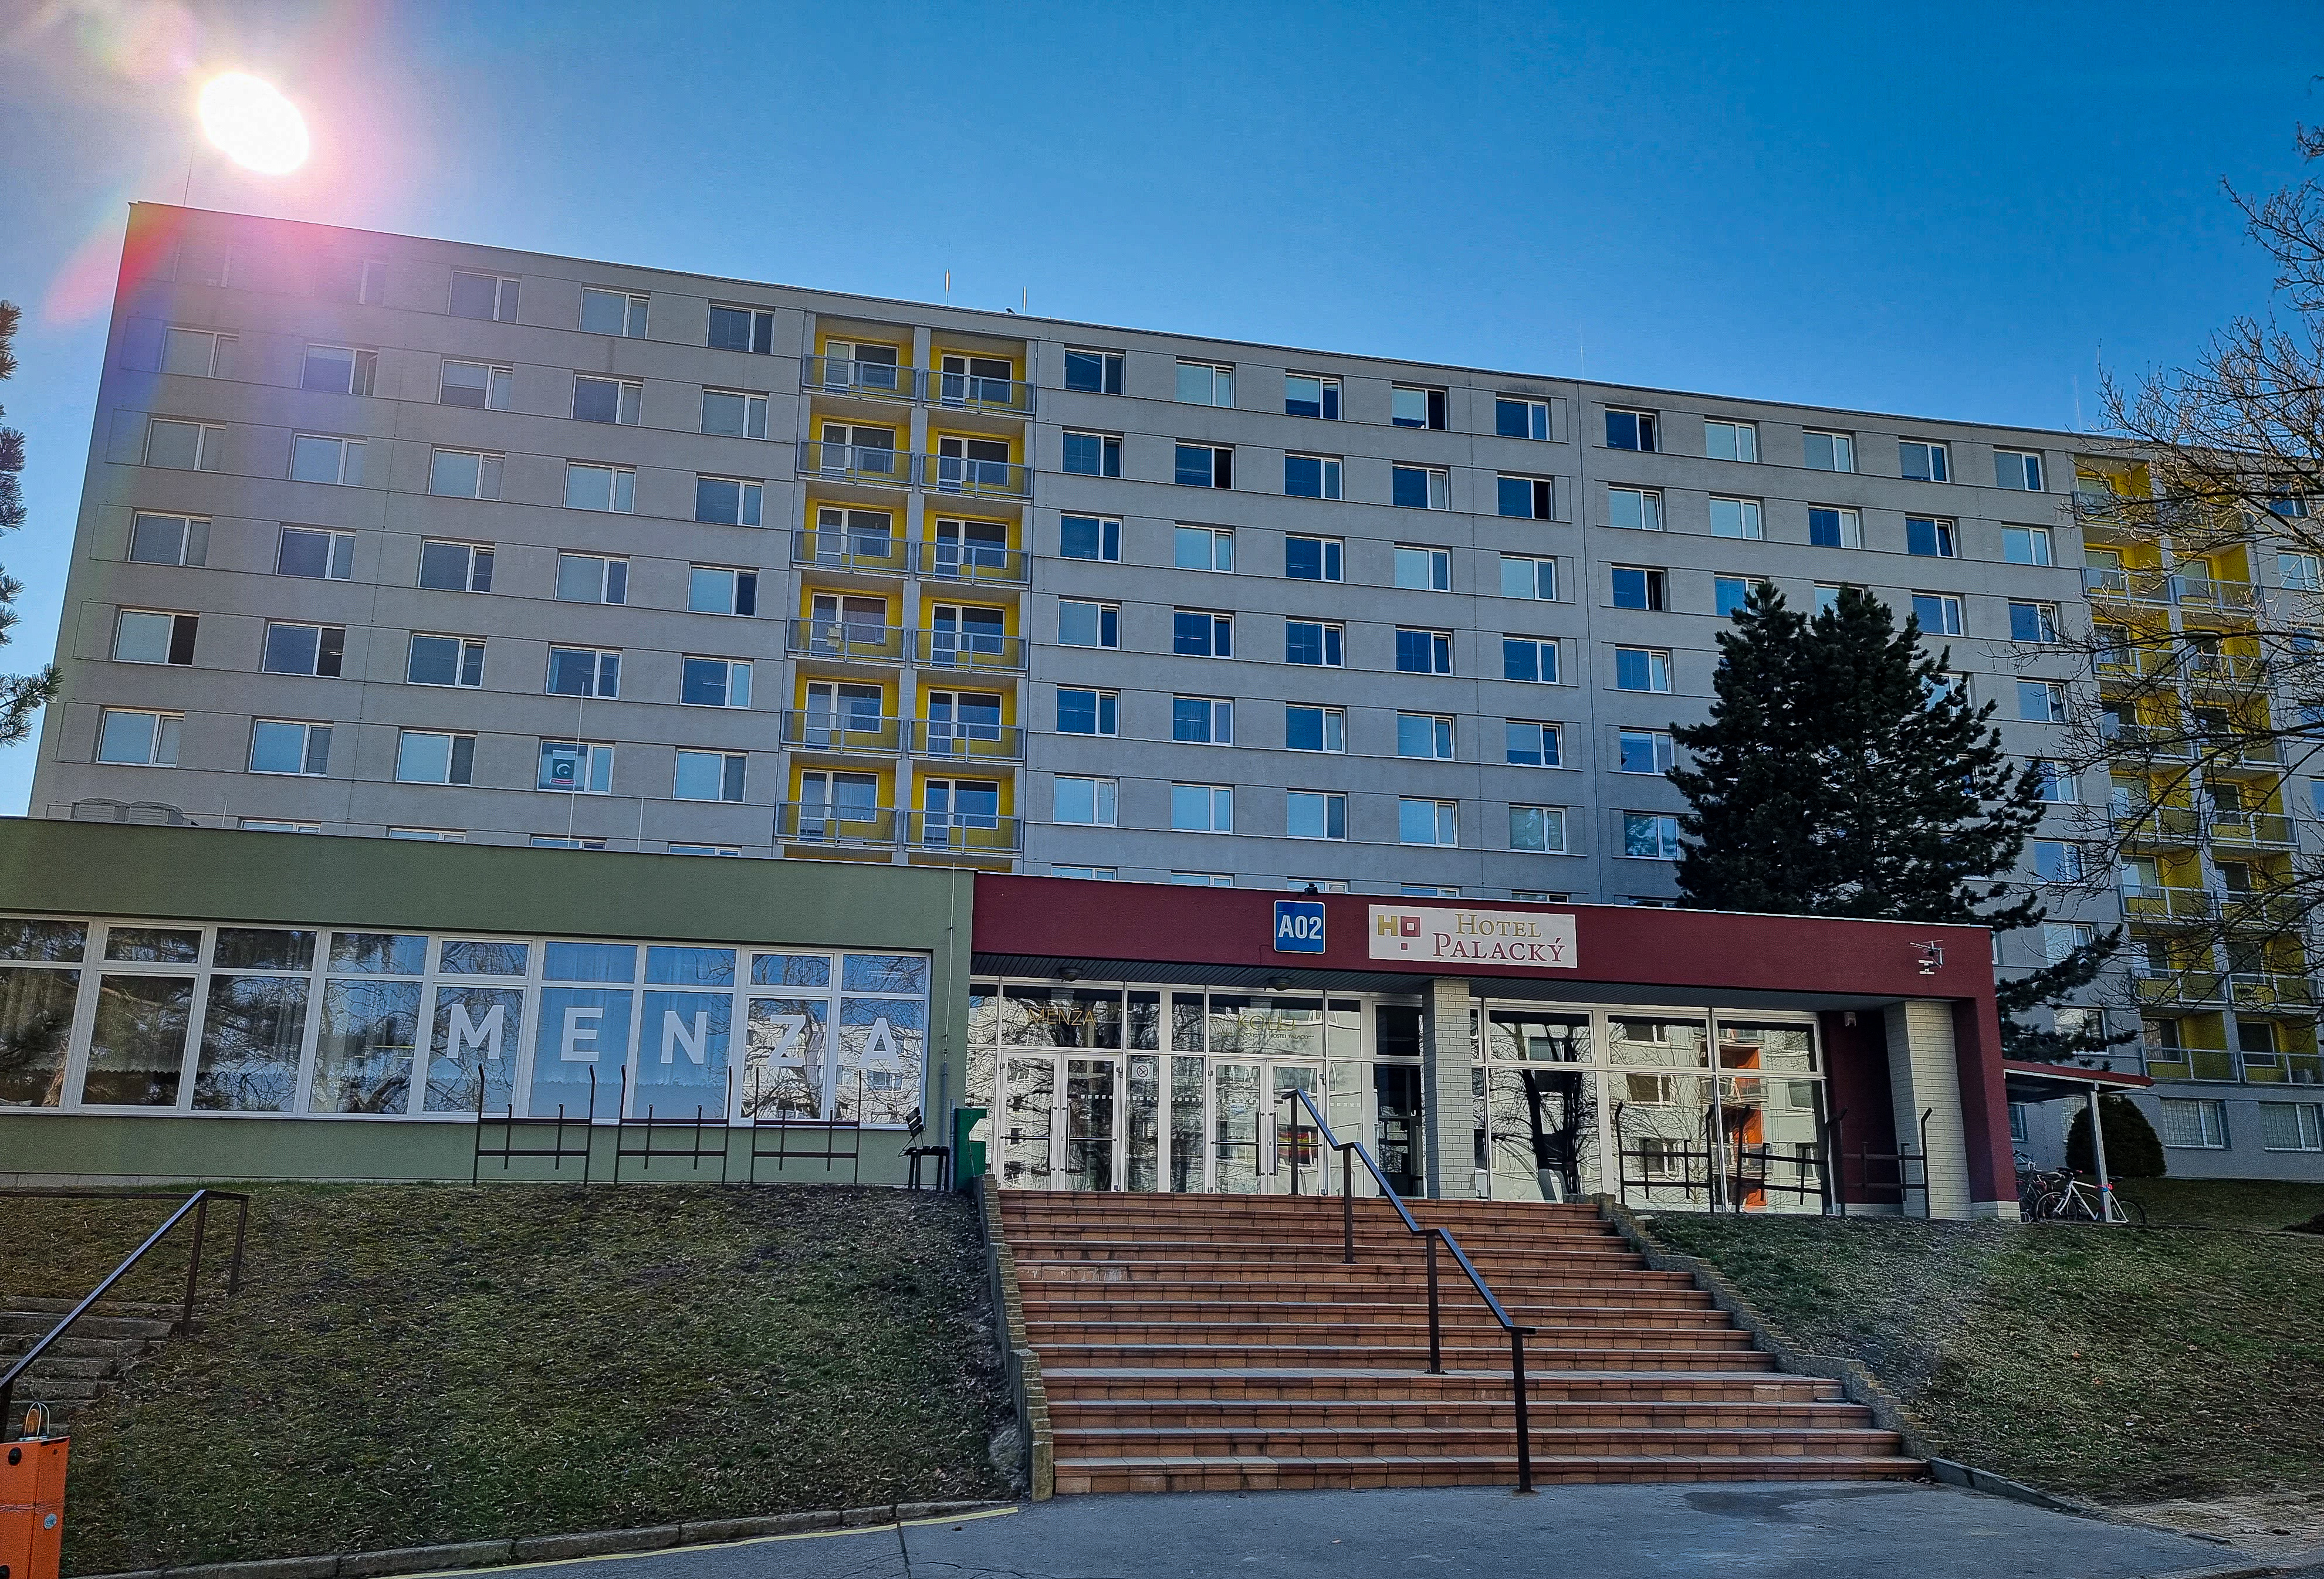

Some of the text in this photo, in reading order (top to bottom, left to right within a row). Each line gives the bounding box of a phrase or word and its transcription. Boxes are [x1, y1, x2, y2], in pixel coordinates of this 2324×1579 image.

[1278, 914, 1322, 940] A02
[1454, 913, 1542, 938] HOTEL
[1432, 933, 1565, 962] PALACKÝ
[1028, 1008, 1097, 1026] MENZA
[446, 1004, 902, 1069] MENZA
